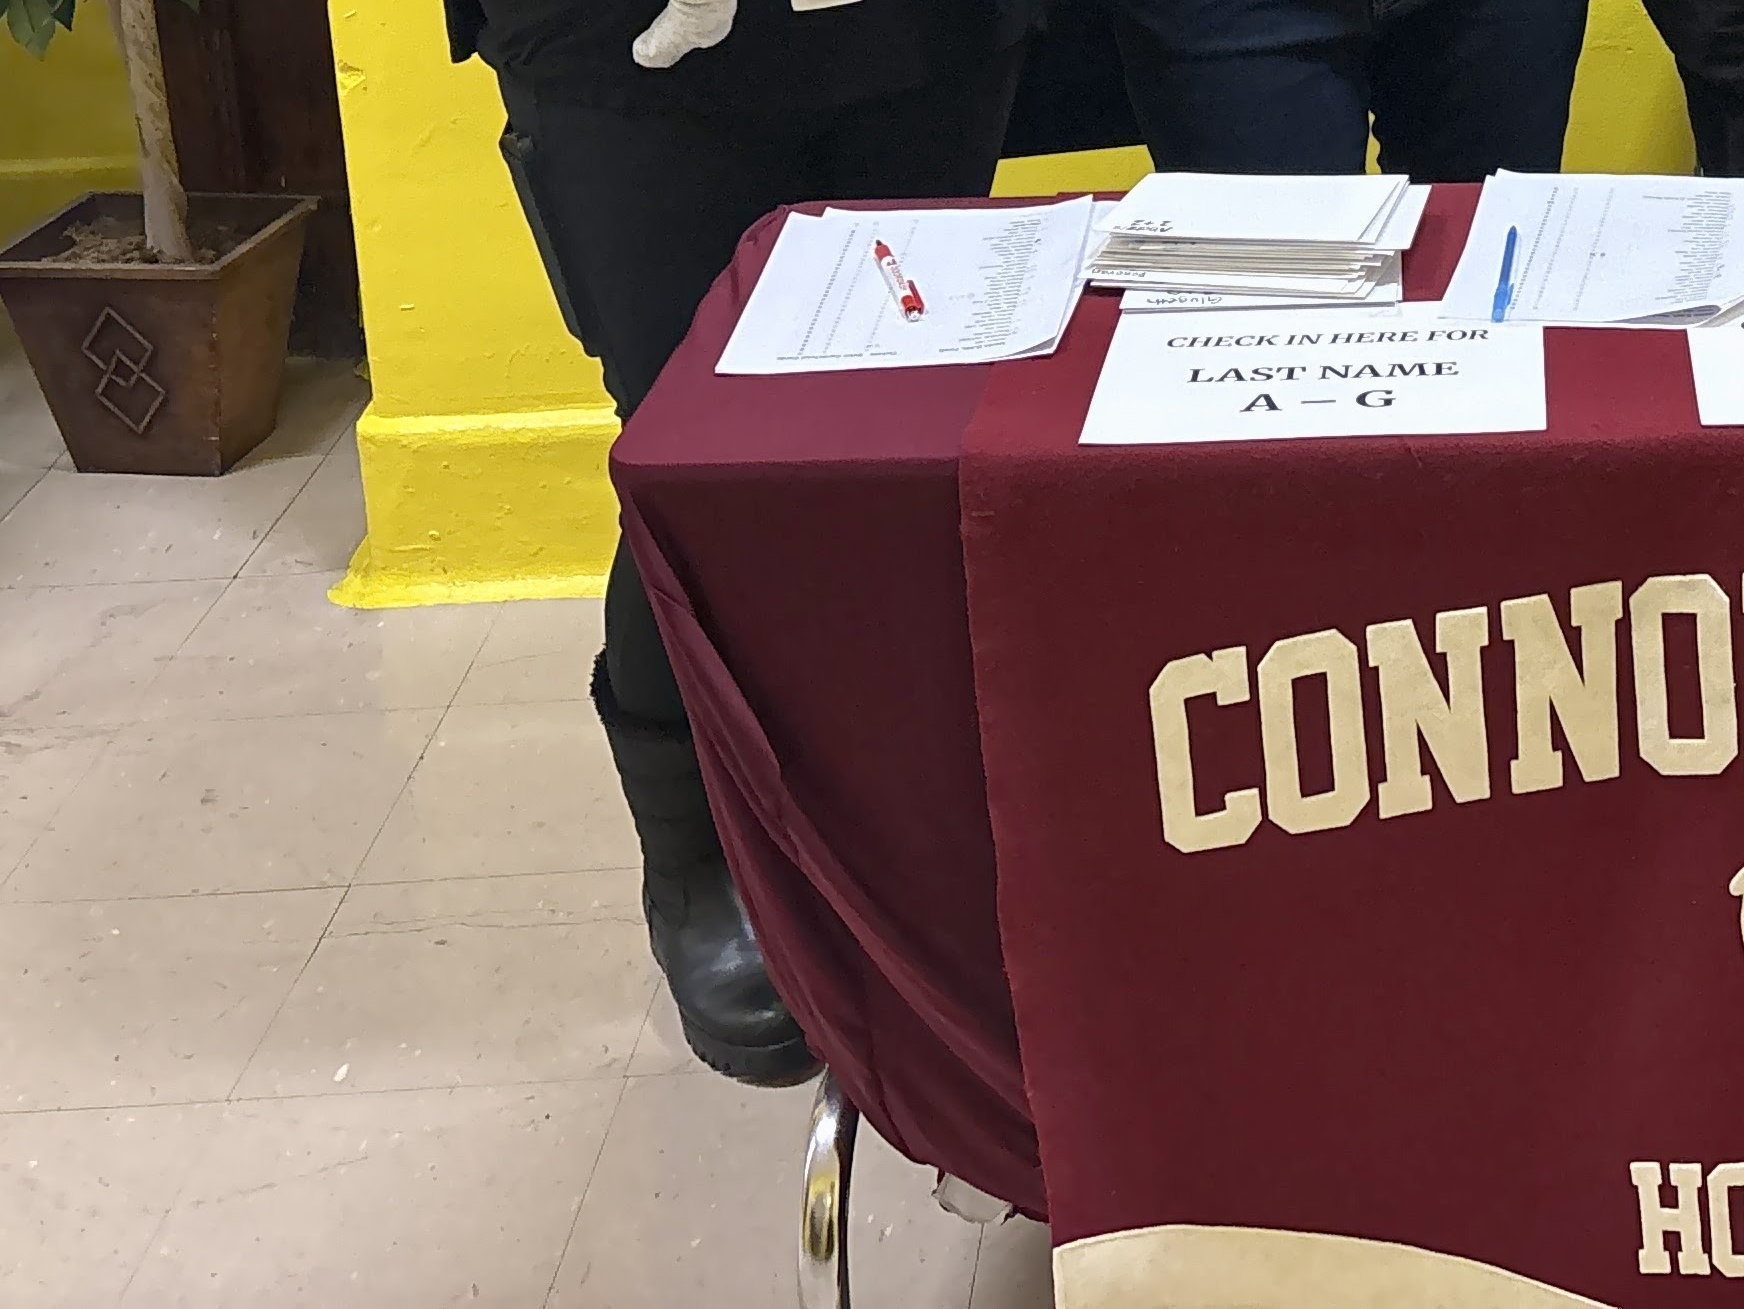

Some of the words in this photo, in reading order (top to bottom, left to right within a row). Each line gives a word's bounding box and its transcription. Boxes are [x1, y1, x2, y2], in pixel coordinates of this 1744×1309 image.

[1167, 334, 1281, 348] CHECK
[1284, 333, 1324, 346] IN
[1329, 330, 1420, 344] HERE
[1425, 328, 1490, 342] FOR
[1187, 365, 1308, 384] LAST
[1317, 361, 1461, 380] NAME
[1239, 392, 1284, 413] A
[1355, 389, 1398, 408] G
